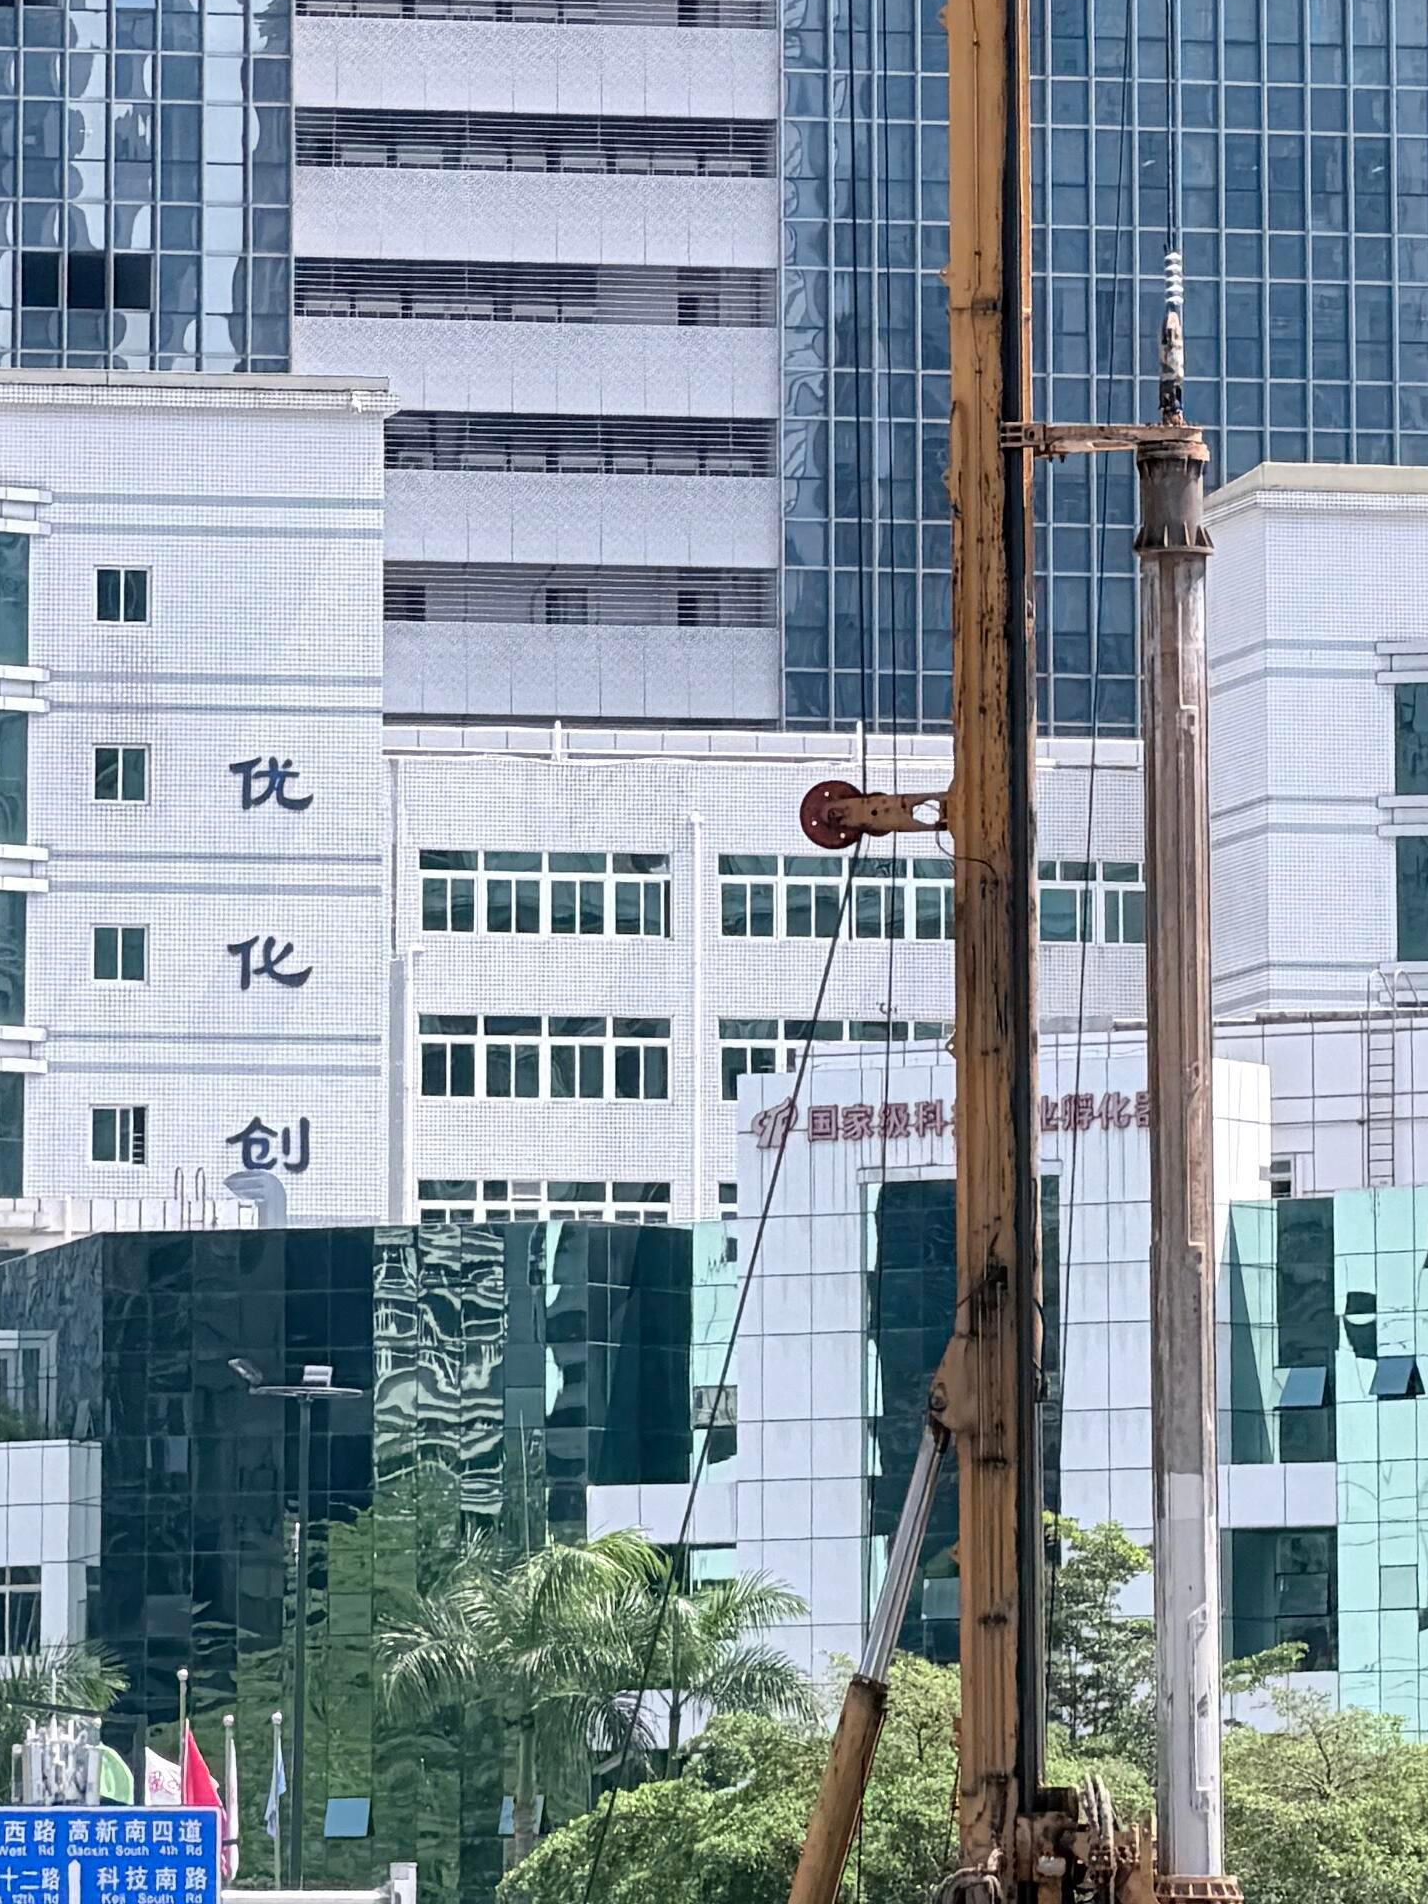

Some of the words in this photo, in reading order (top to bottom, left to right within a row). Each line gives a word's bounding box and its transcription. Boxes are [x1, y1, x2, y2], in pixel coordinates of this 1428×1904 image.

[68, 1819, 203, 1843] 高新南四道
[38, 1845, 55, 1856] Rd
[115, 1844, 149, 1856] South
[159, 1845, 178, 1856] 4th
[185, 1845, 203, 1856] Rd
[96, 1866, 207, 1891] 科技南路
[44, 1893, 59, 1904] Rd
[137, 1892, 174, 1904] South
[185, 1892, 203, 1904] Rd
